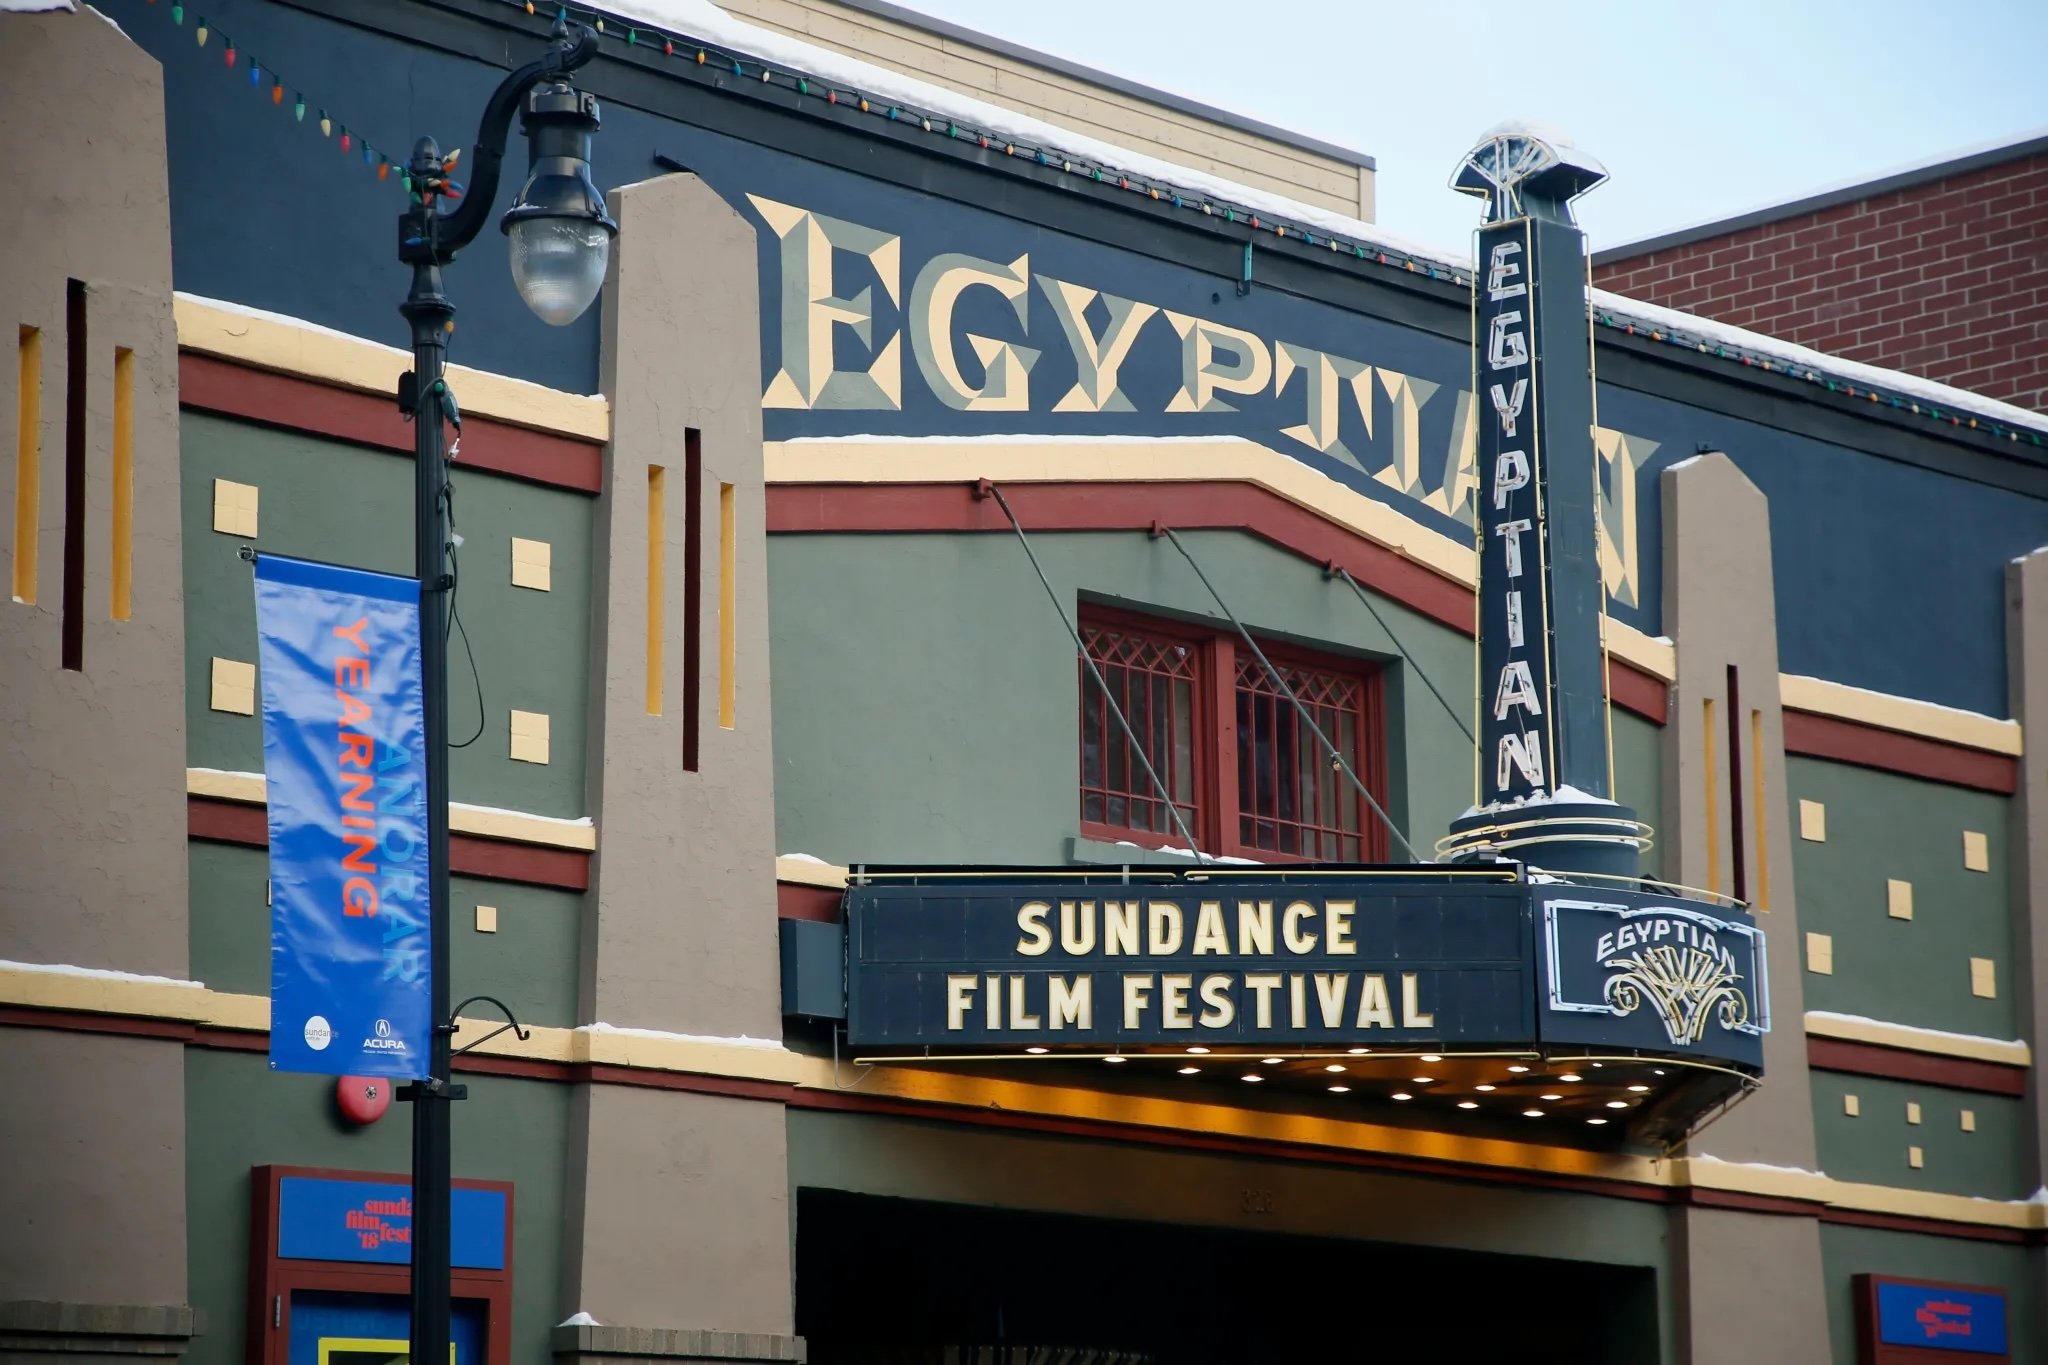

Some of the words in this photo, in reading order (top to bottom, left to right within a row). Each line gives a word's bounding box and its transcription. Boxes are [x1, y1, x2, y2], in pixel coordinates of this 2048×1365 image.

[745, 193, 1661, 609] EGYPTIAN
[1488, 241, 1544, 791] EGYPTIAN
[333, 617, 379, 918] YEARNING
[1016, 900, 1357, 956] SUNDANCE
[1597, 920, 1735, 984] EGYPTIAN
[947, 974, 1092, 1030] FILM
[1123, 973, 1434, 1030] FESTIVAL
[363, 1038, 406, 1050] ACURA
[346, 1210, 380, 1230] film
[365, 1198, 412, 1216] sunda
[381, 1222, 412, 1243] fest
